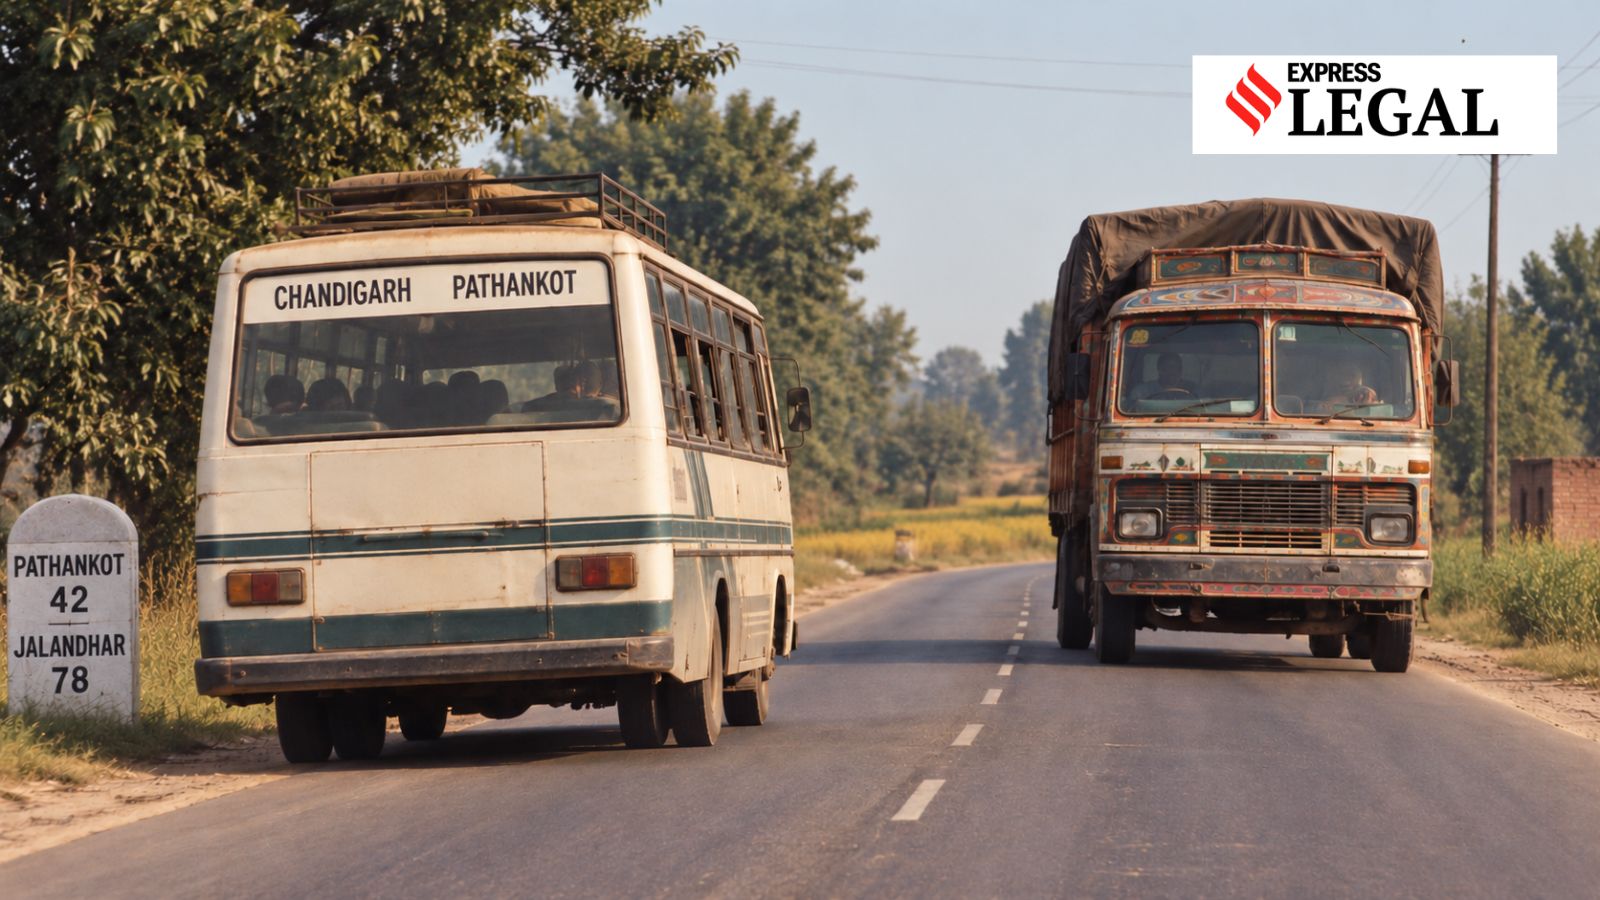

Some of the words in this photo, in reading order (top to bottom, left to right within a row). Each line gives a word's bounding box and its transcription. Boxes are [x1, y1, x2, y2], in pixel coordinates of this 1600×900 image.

[274, 277, 412, 311] CHANDIGARH
[452, 269, 578, 300] PATHANKOT
[14, 553, 125, 578] PATHANKOT
[49, 585, 89, 613] 42
[13, 634, 126, 658] JALANDHAR
[51, 665, 89, 694] 78
